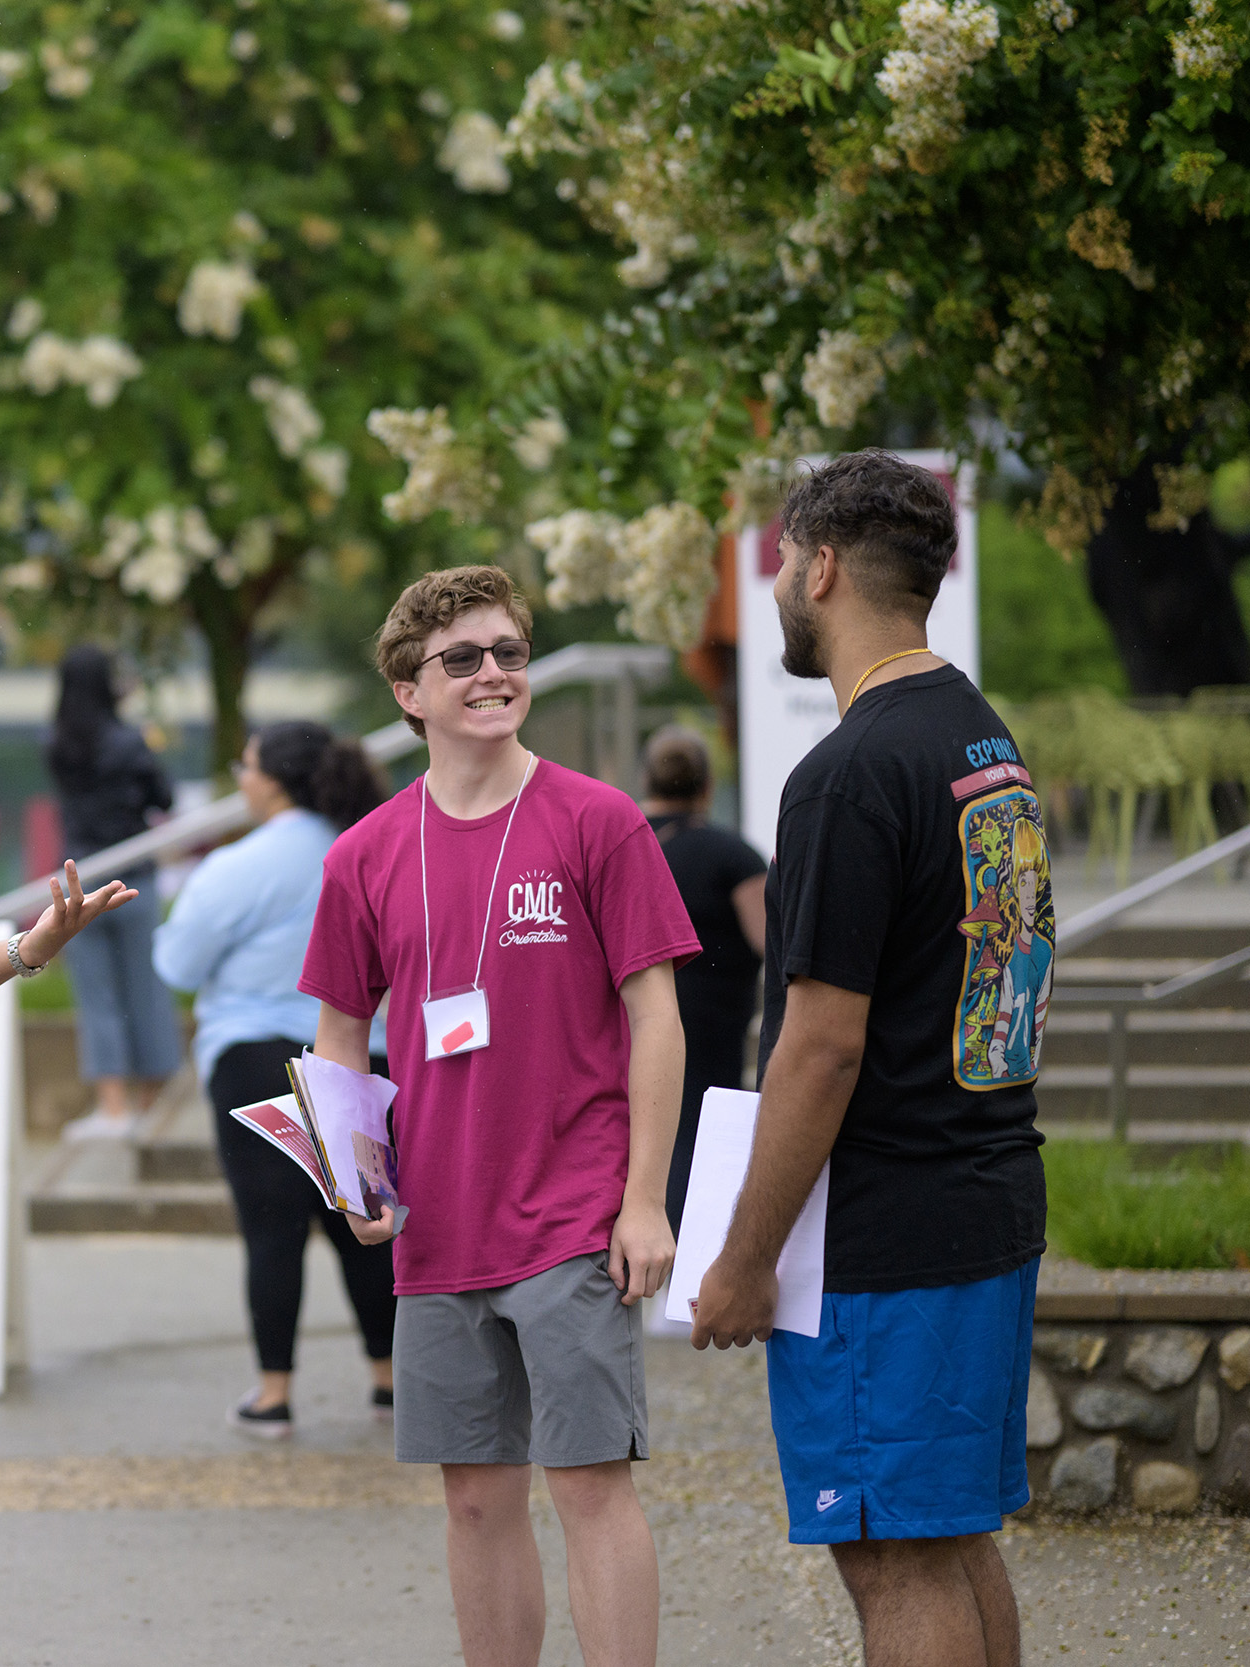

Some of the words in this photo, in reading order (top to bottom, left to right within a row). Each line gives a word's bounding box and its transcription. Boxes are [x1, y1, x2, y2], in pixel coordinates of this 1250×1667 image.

[965, 737, 1017, 768] EXPAND
[984, 766, 1007, 782] YOUR
[507, 881, 563, 920] CMC
[498, 928, 568, 947] Orientation
[819, 1489, 837, 1502] NIKE
